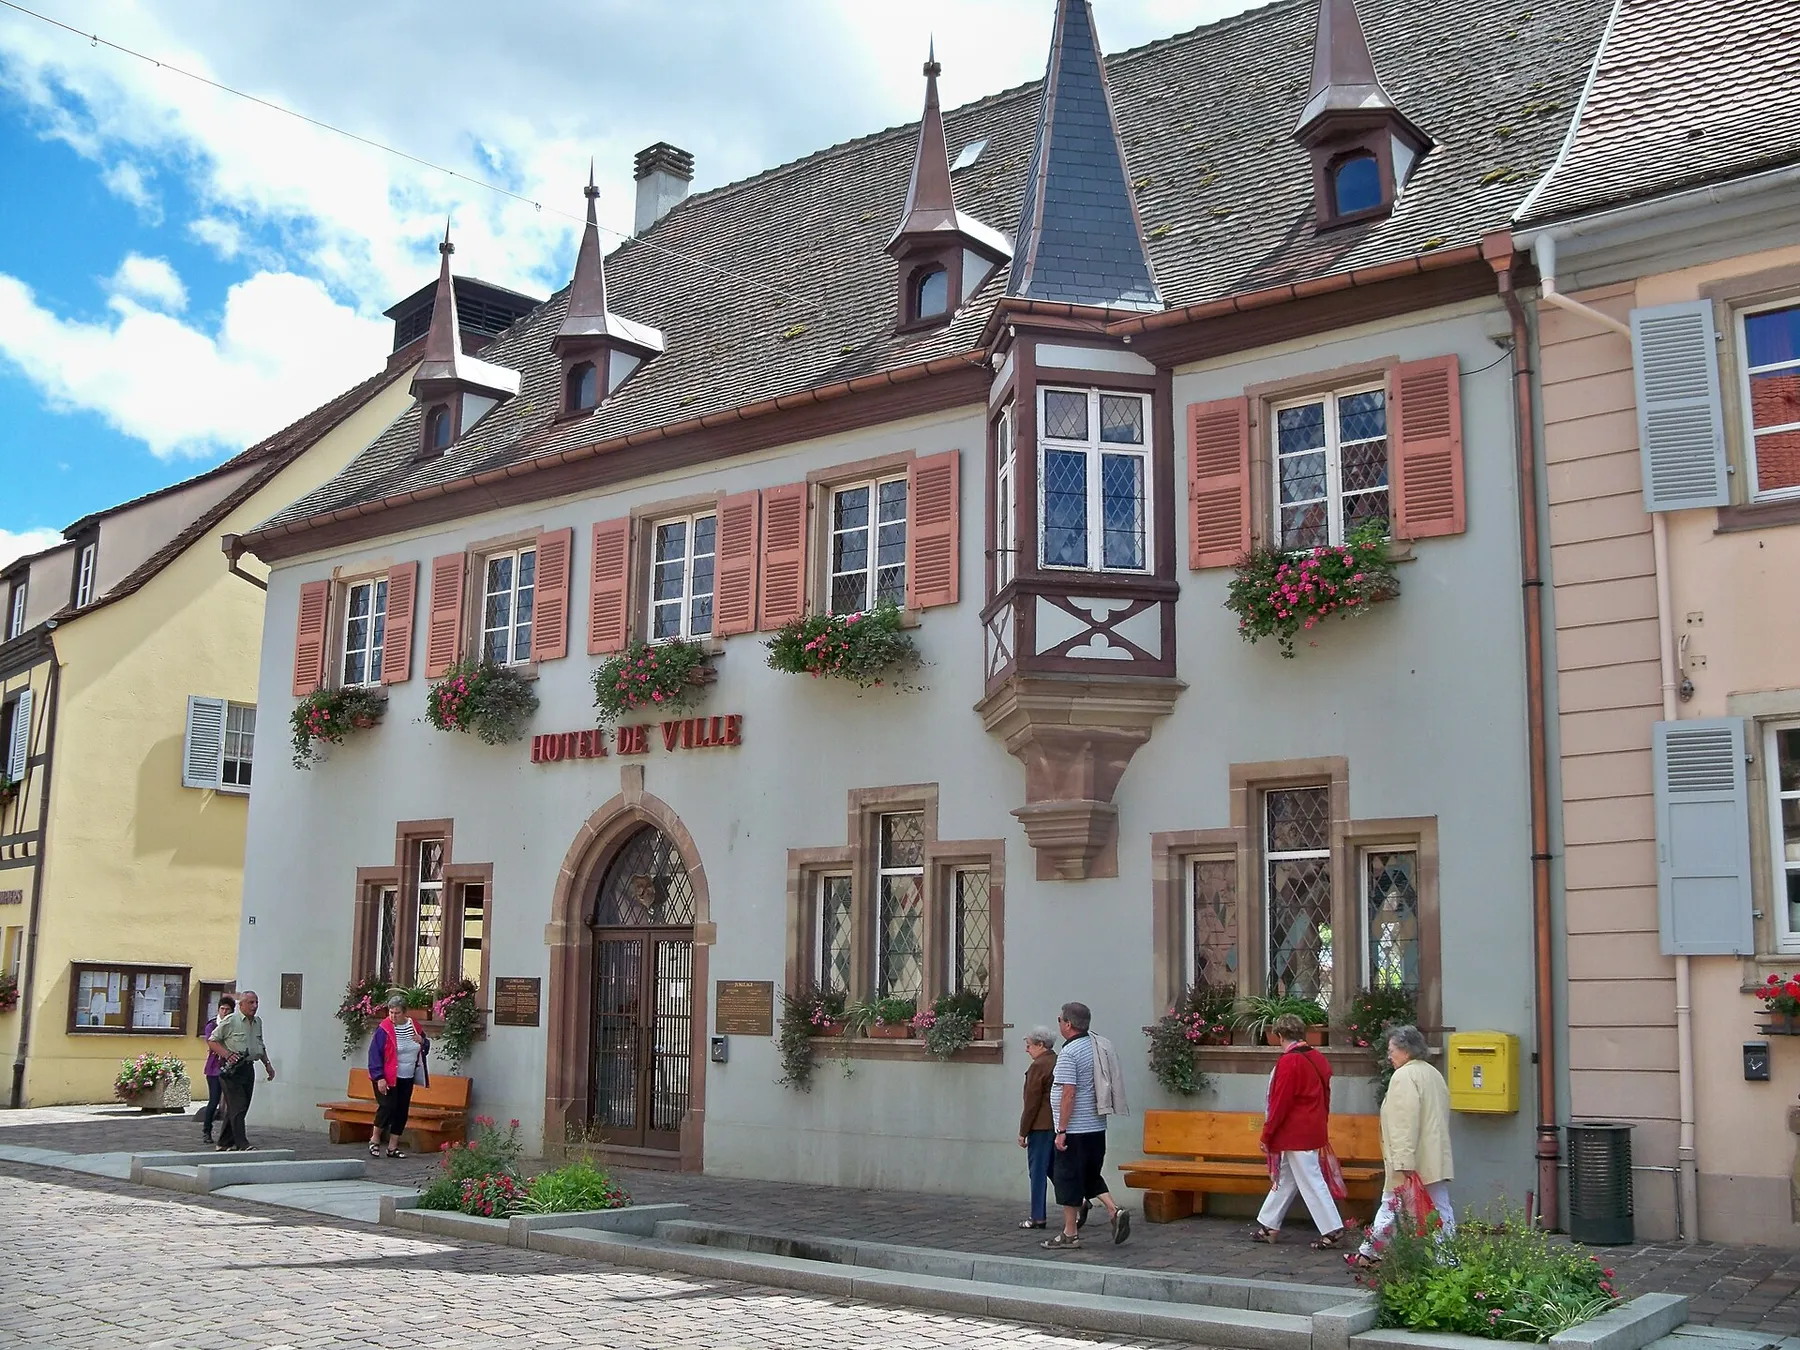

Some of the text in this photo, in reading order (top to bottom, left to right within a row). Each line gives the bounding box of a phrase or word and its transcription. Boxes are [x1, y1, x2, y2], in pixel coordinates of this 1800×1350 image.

[530, 714, 744, 764] HOTEL DE VILLE
